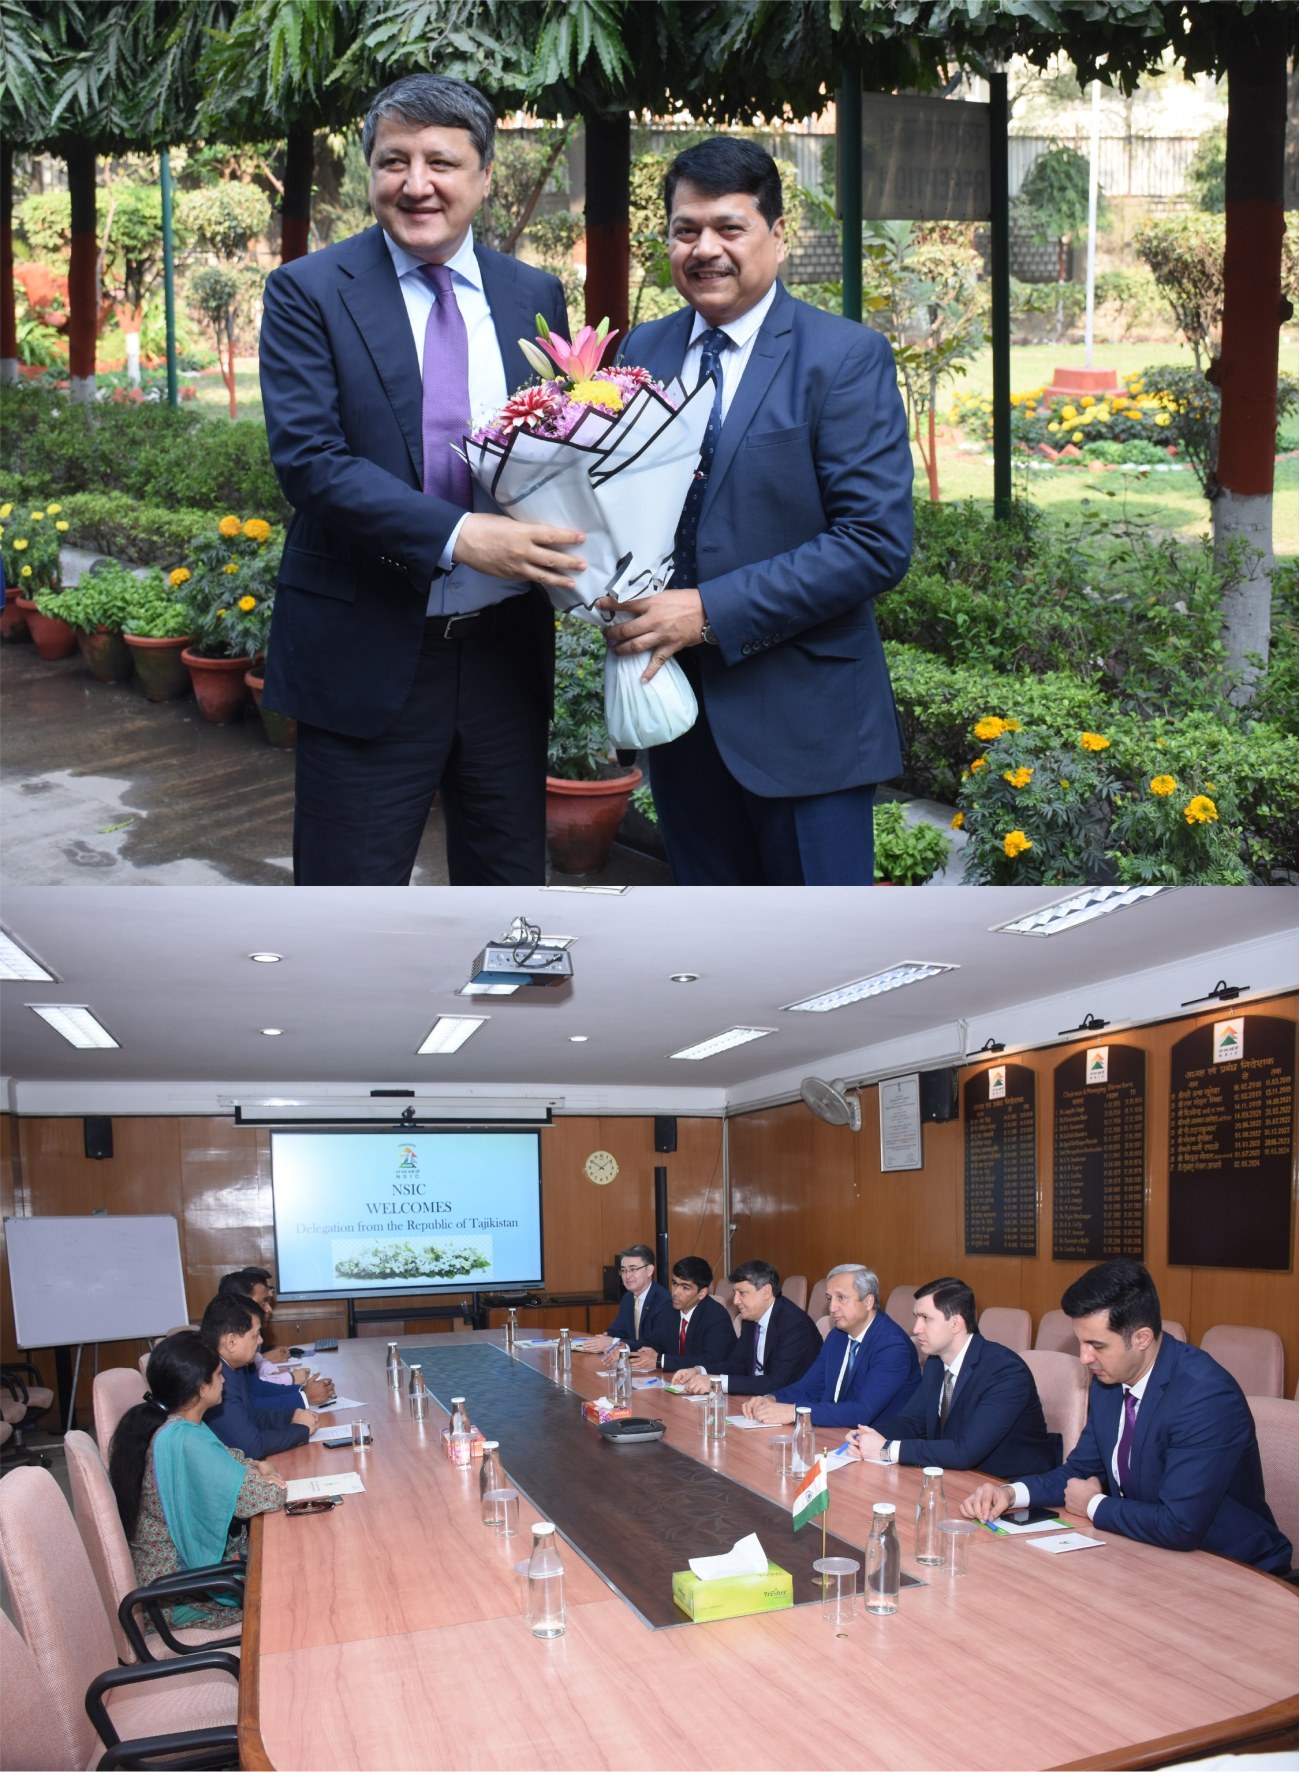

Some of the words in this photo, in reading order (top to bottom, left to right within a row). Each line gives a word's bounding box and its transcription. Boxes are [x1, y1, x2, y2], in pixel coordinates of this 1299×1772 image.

[392, 1183, 426, 1196] NSIC
[366, 1201, 452, 1214] WELCOMES
[296, 1222, 354, 1235] Delegation
[357, 1221, 384, 1232] from
[387, 1220, 403, 1231] the
[407, 1218, 453, 1232] Republic
[456, 1218, 467, 1229] of
[469, 1217, 519, 1231] Tajikistan
